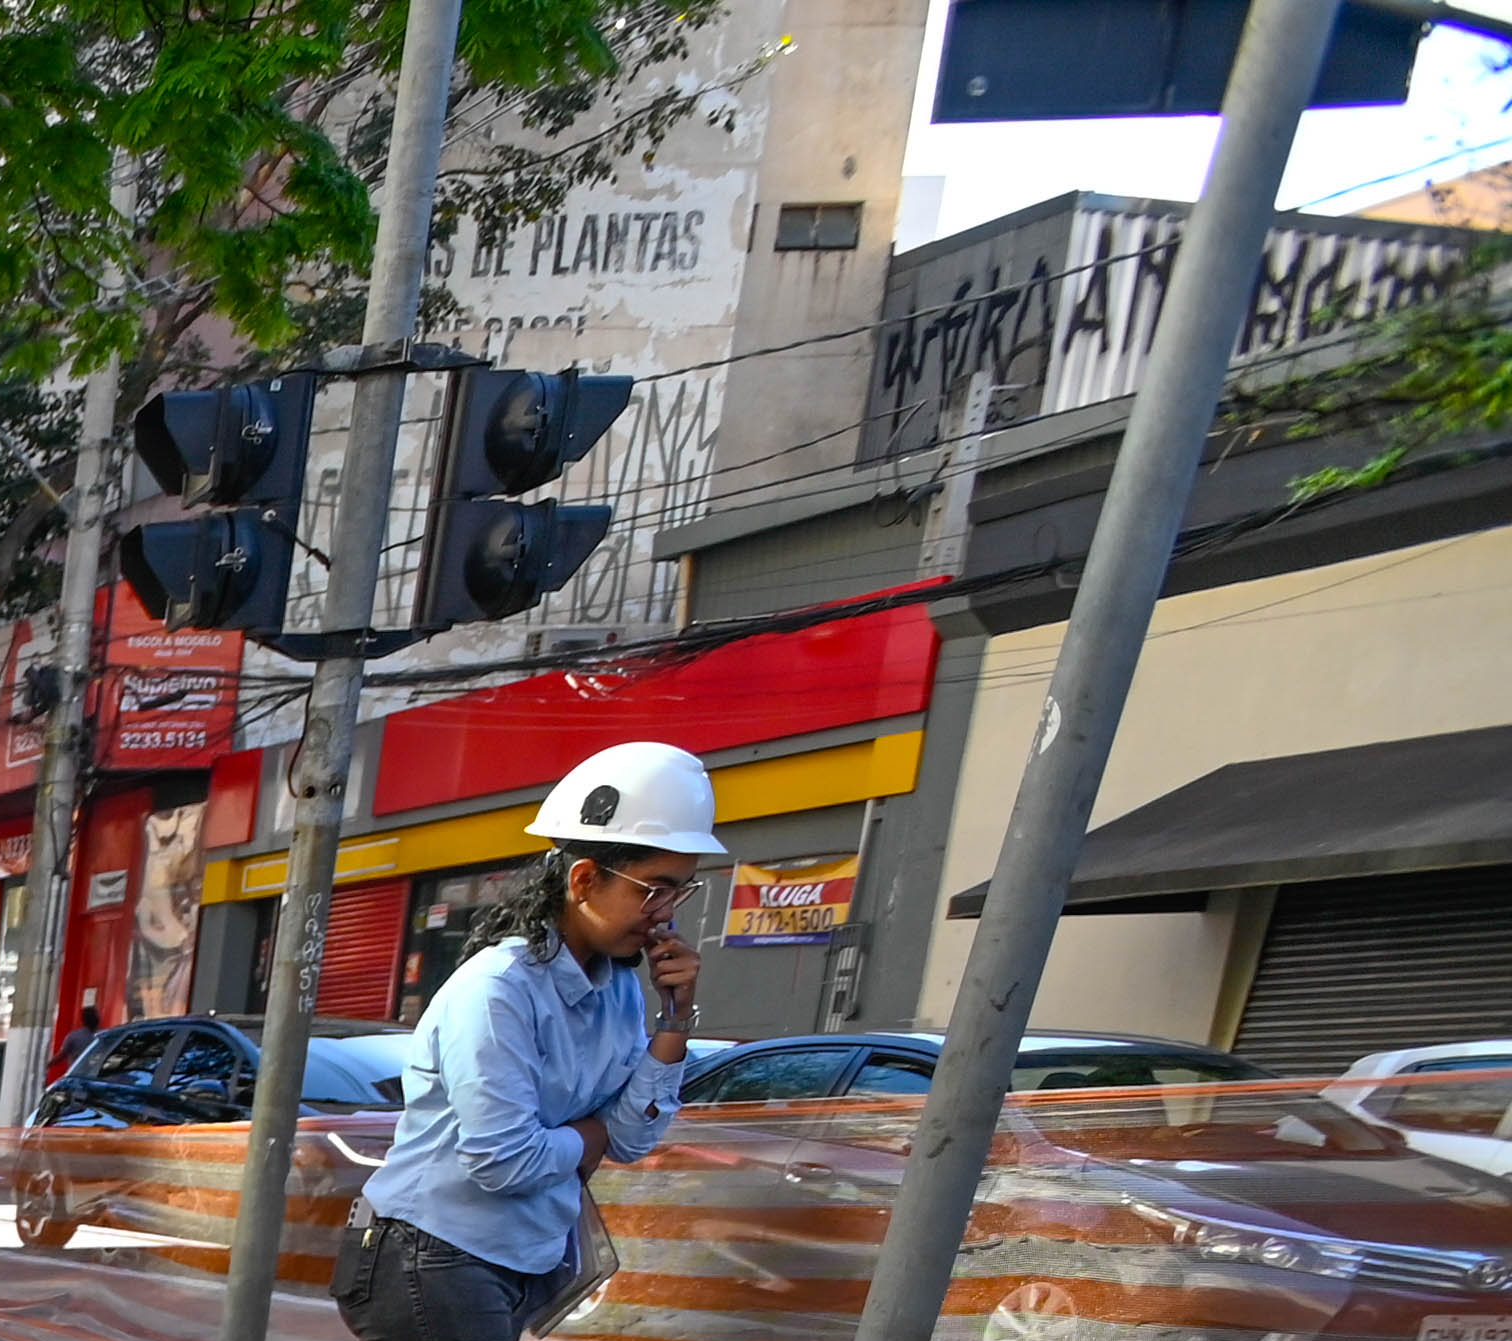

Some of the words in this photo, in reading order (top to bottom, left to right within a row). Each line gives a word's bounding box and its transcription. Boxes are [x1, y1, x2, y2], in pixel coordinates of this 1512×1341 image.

[528, 209, 705, 277] PLANTAS
[174, 635, 223, 647] MODELO
[759, 882, 825, 908] ALUGA
[741, 907, 834, 934] 3112-1500
